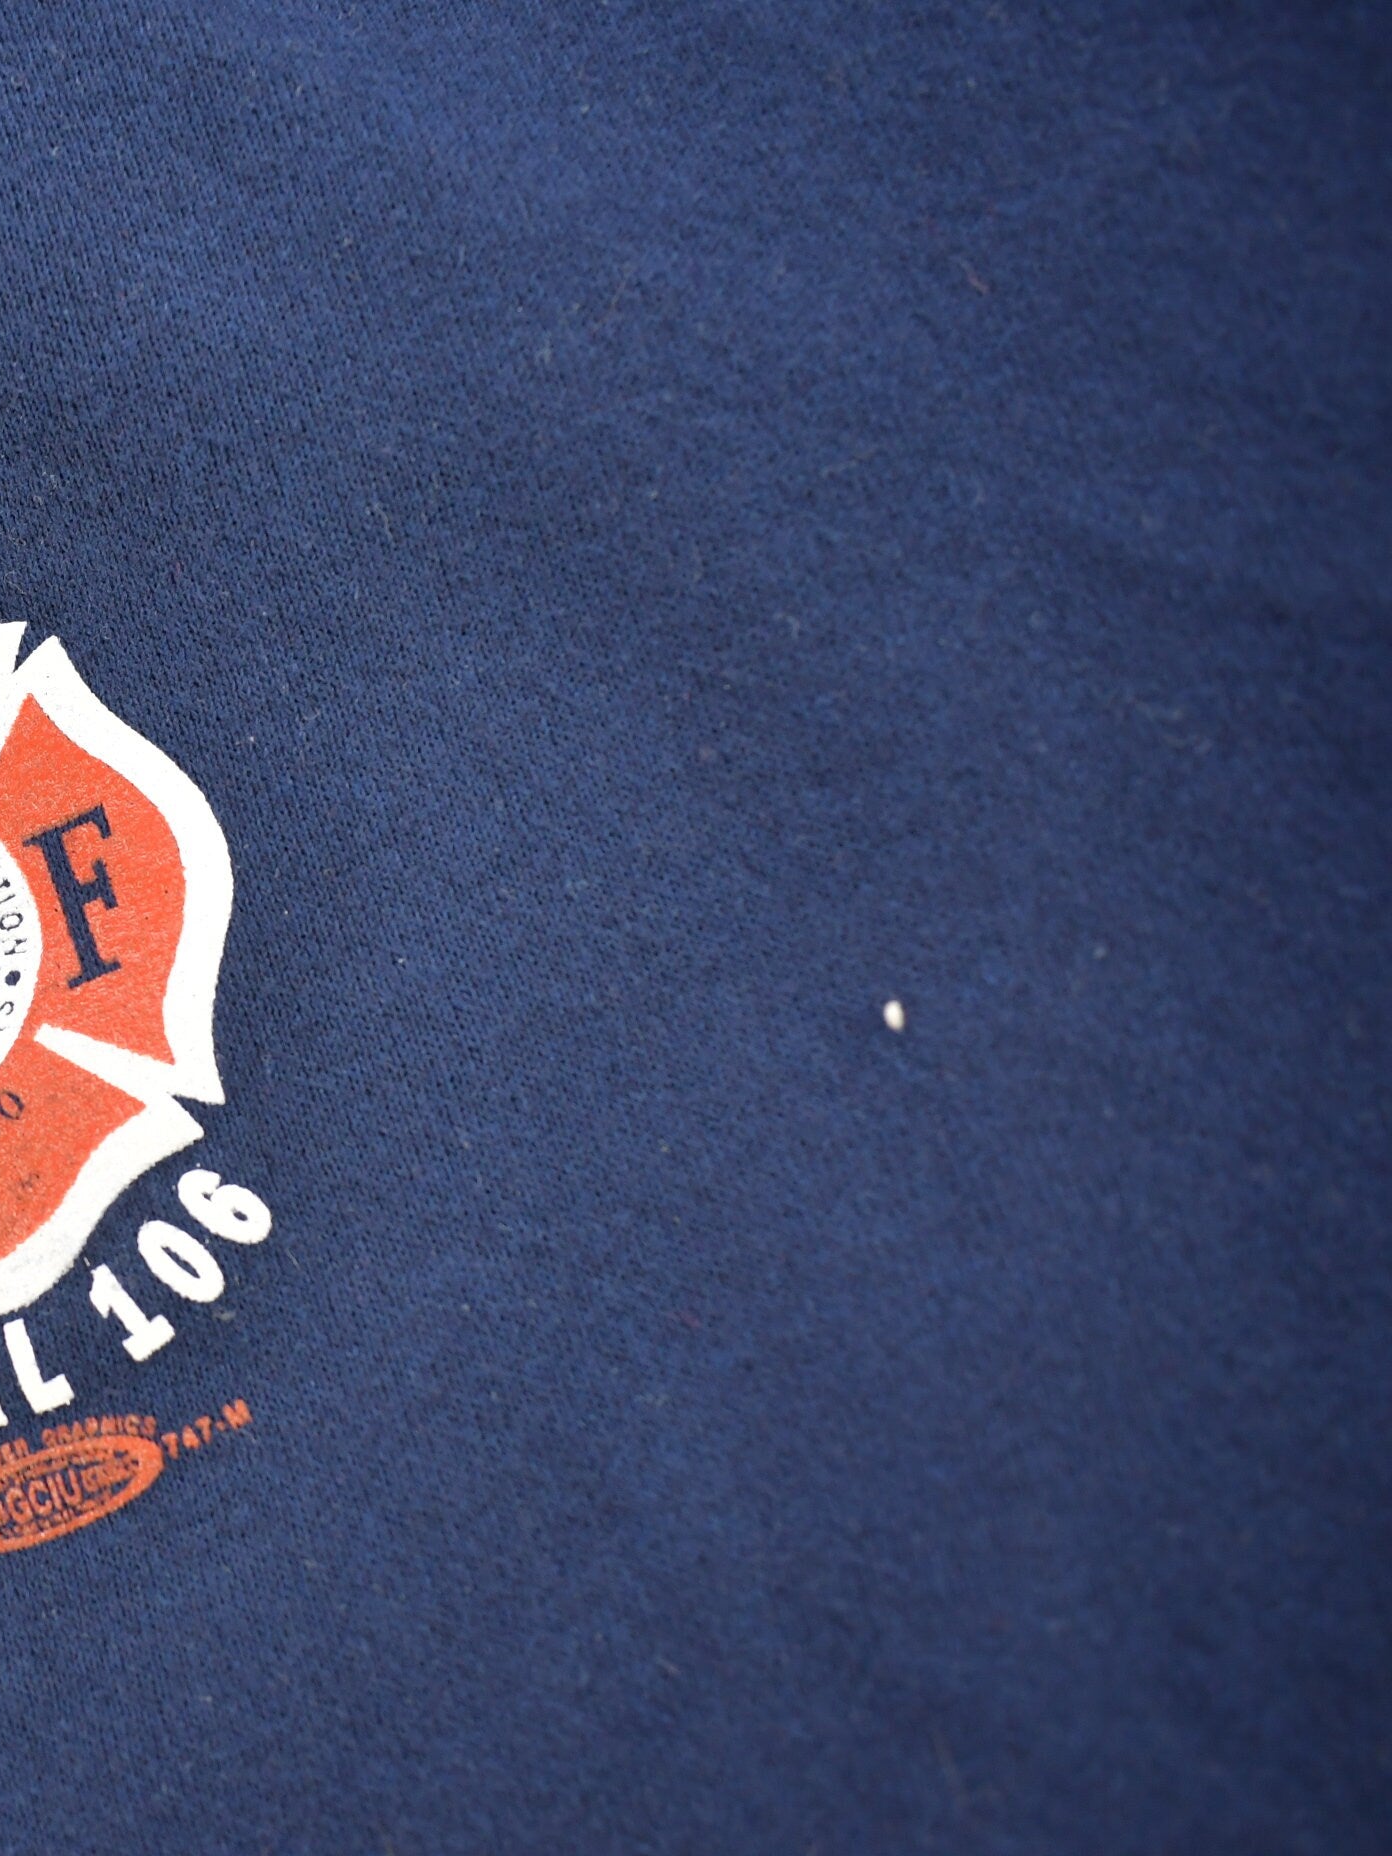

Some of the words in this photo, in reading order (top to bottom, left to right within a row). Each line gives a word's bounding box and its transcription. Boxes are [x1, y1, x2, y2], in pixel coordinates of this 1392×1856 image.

[23, 803, 122, 989] F
[88, 1168, 273, 1362] 106
[5, 1467, 84, 1525] GCIU
